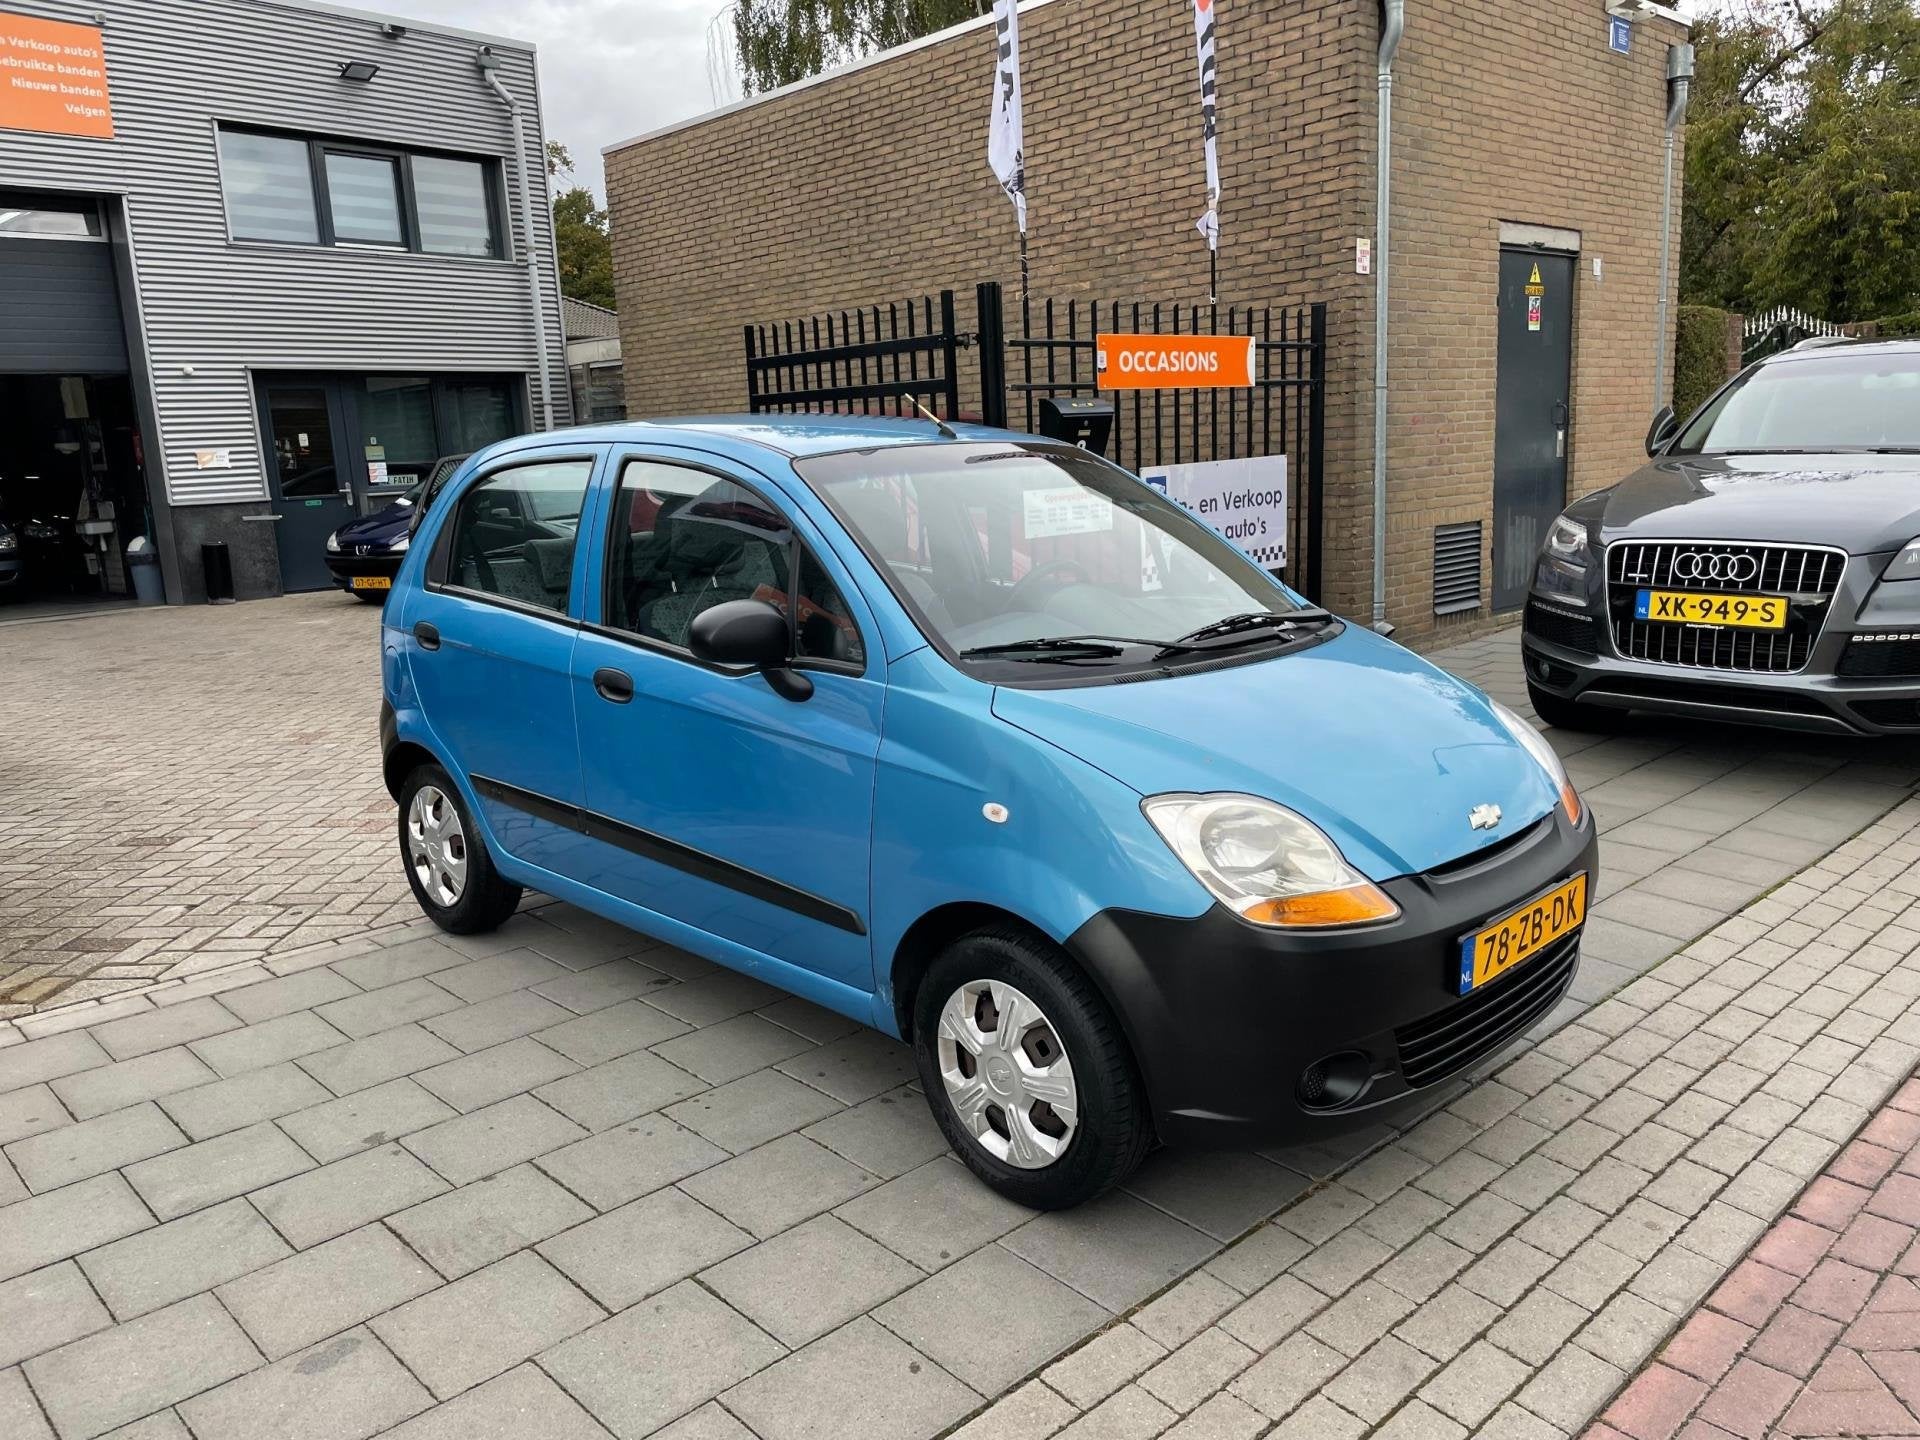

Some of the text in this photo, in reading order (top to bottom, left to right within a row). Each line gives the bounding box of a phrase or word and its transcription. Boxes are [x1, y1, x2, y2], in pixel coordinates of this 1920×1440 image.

[8, 36, 61, 54] Verkoop
[64, 46, 98, 58] auto's
[0, 56, 101, 78] ebruikte banden
[11, 77, 103, 97] Nieuwe banden
[65, 104, 106, 117] Velgen
[1119, 351, 1219, 372] OCCASIONS
[1199, 496, 1218, 513] en
[1223, 488, 1283, 512] Verkoop
[1225, 517, 1267, 539] auto's
[1638, 596, 1776, 623] NL XK-949-S
[1461, 886, 1578, 985] NL 78-ZB-DK
